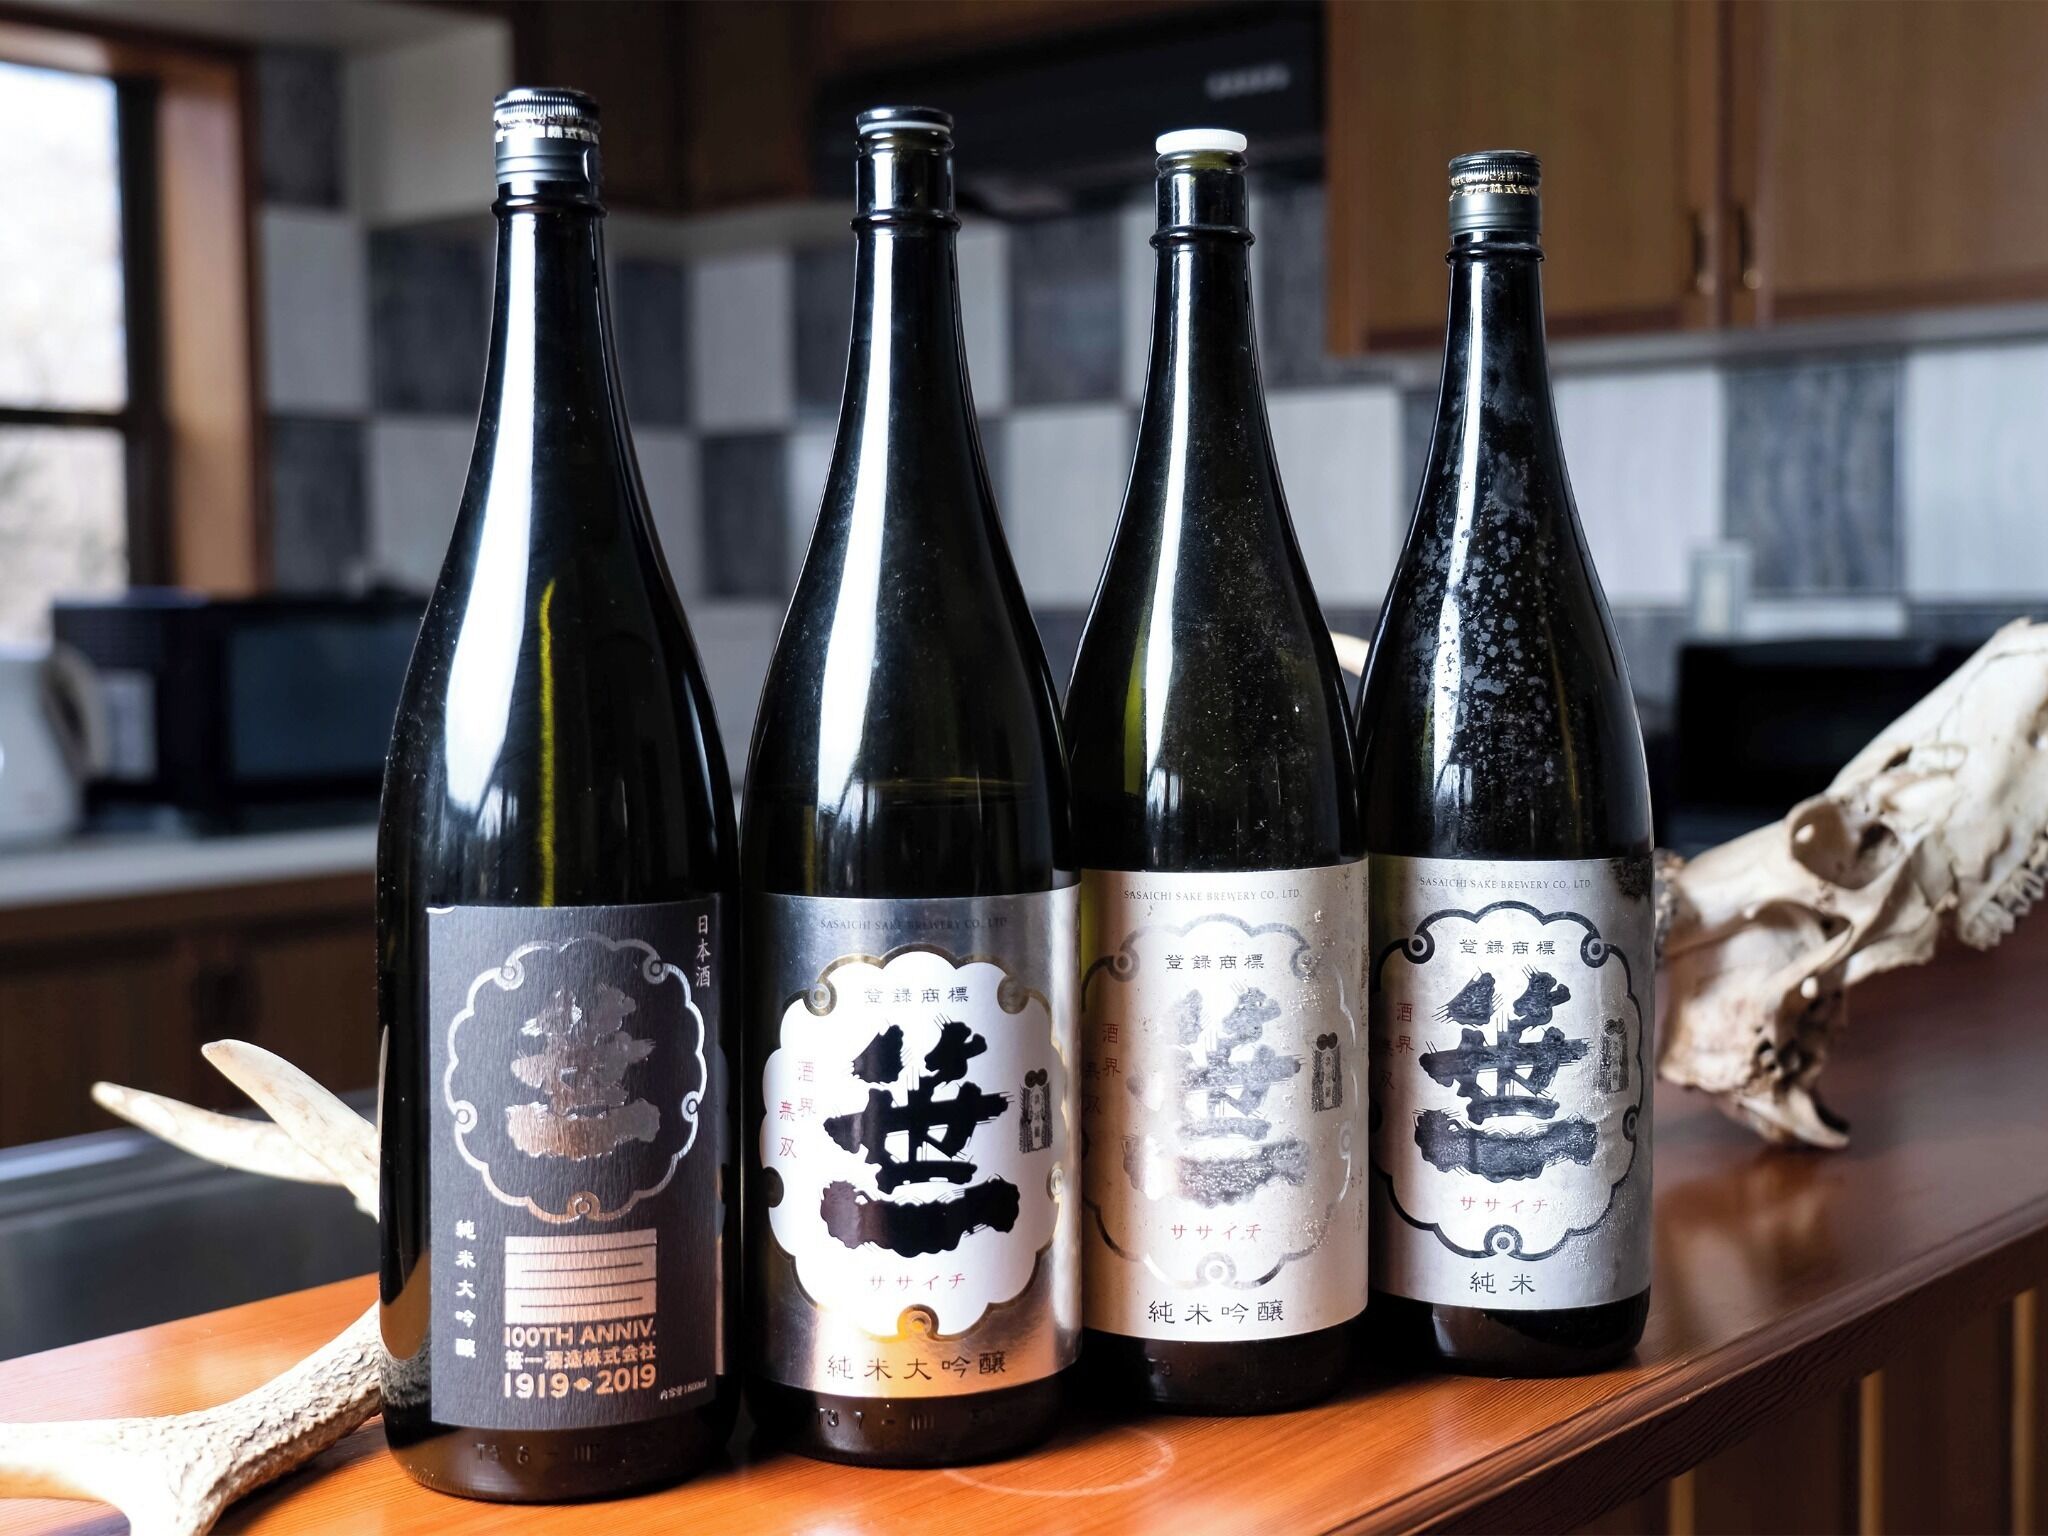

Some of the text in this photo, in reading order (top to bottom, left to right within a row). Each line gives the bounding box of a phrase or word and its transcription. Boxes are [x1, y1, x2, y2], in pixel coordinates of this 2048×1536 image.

[1420, 877, 1467, 888] SASAICHI
[1470, 880, 1497, 889] SAKE
[1500, 880, 1550, 889] BREWERY
[1124, 890, 1171, 901] SASAICHI
[1176, 891, 1202, 901] SAKE
[1206, 891, 1256, 901] BREWERY
[820, 918, 871, 930] SASAICHI
[696, 914, 711, 987] 日本酒
[1459, 939, 1556, 955] 登録商標
[1165, 953, 1265, 970] 登録商標
[864, 986, 969, 1004] 登録商標
[1460, 1196, 1548, 1214] ササイチ
[1171, 1224, 1262, 1241] ササイチ
[455, 1219, 476, 1358] 純米大吟醸
[870, 1273, 966, 1291] ササイチ
[1469, 1271, 1536, 1295] 純米
[1148, 1299, 1284, 1325] 純米吟醸
[504, 1318, 657, 1348] 100TH ANNIV.
[827, 1350, 1006, 1381] 純米大吟醸
